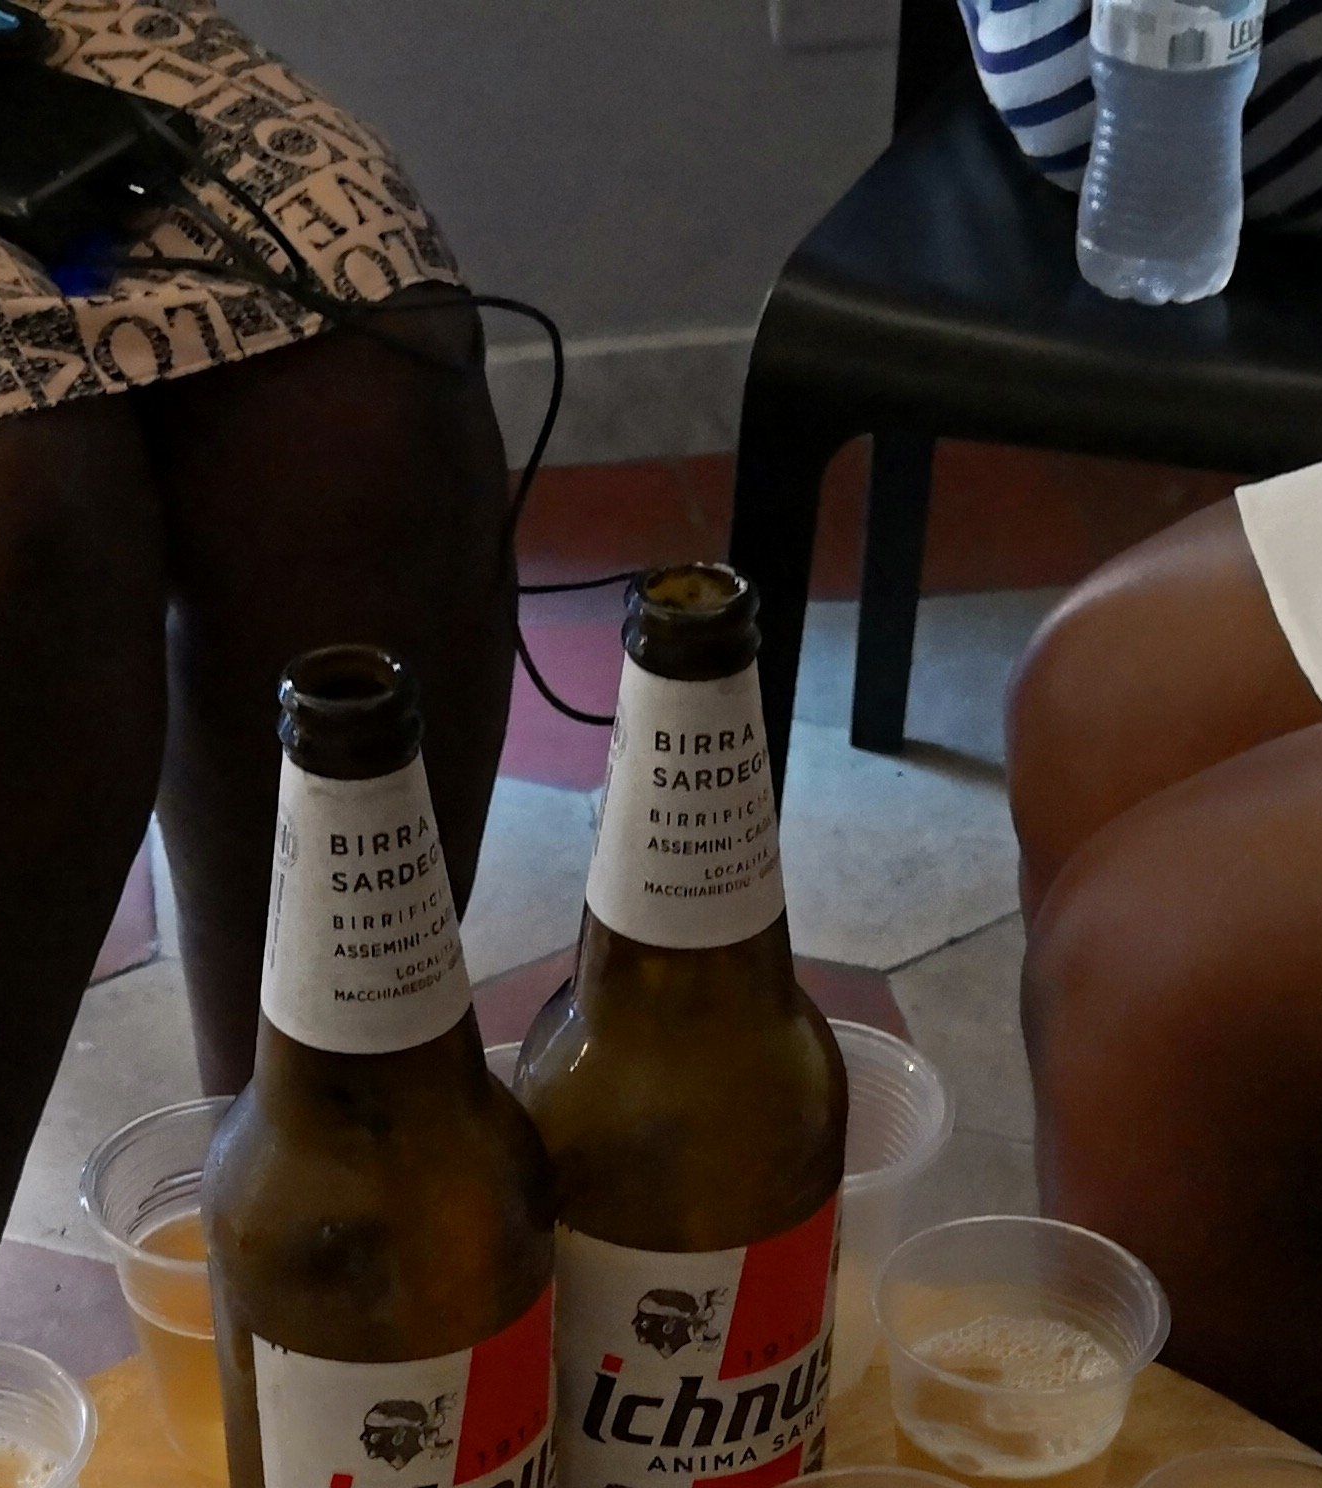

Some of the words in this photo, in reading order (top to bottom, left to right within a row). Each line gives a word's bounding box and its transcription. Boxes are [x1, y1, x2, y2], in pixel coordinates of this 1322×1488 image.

[654, 723, 755, 755] BIRRA
[330, 815, 428, 856] BIRRA
[647, 1446, 757, 1474] ANIMA
